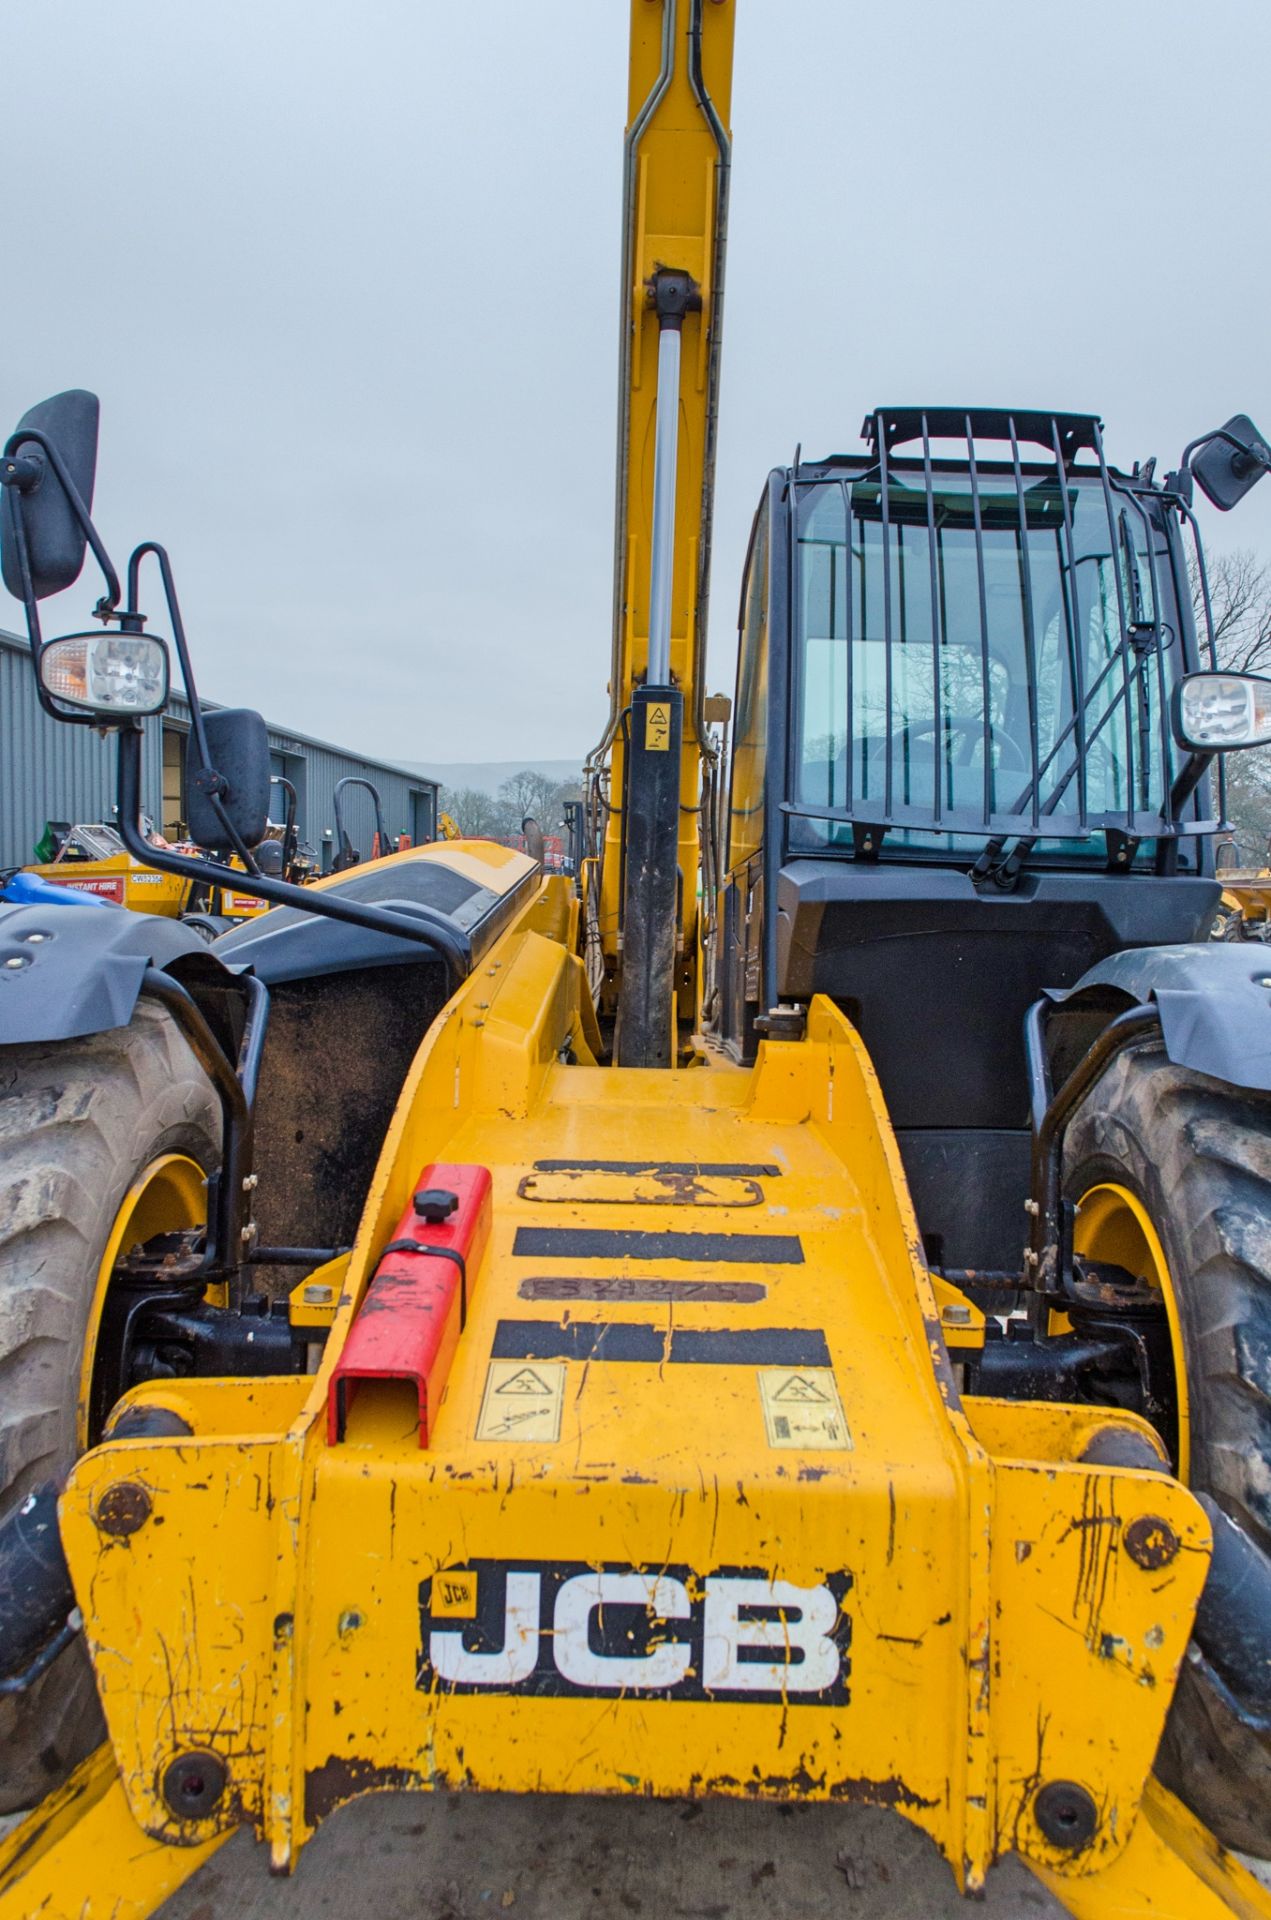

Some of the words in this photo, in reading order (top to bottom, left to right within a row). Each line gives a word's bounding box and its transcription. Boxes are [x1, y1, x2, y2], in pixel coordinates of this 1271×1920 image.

[99, 881, 117, 890] HIRE
[445, 1583, 469, 1604] JCB
[430, 1572, 840, 1692] JCB
